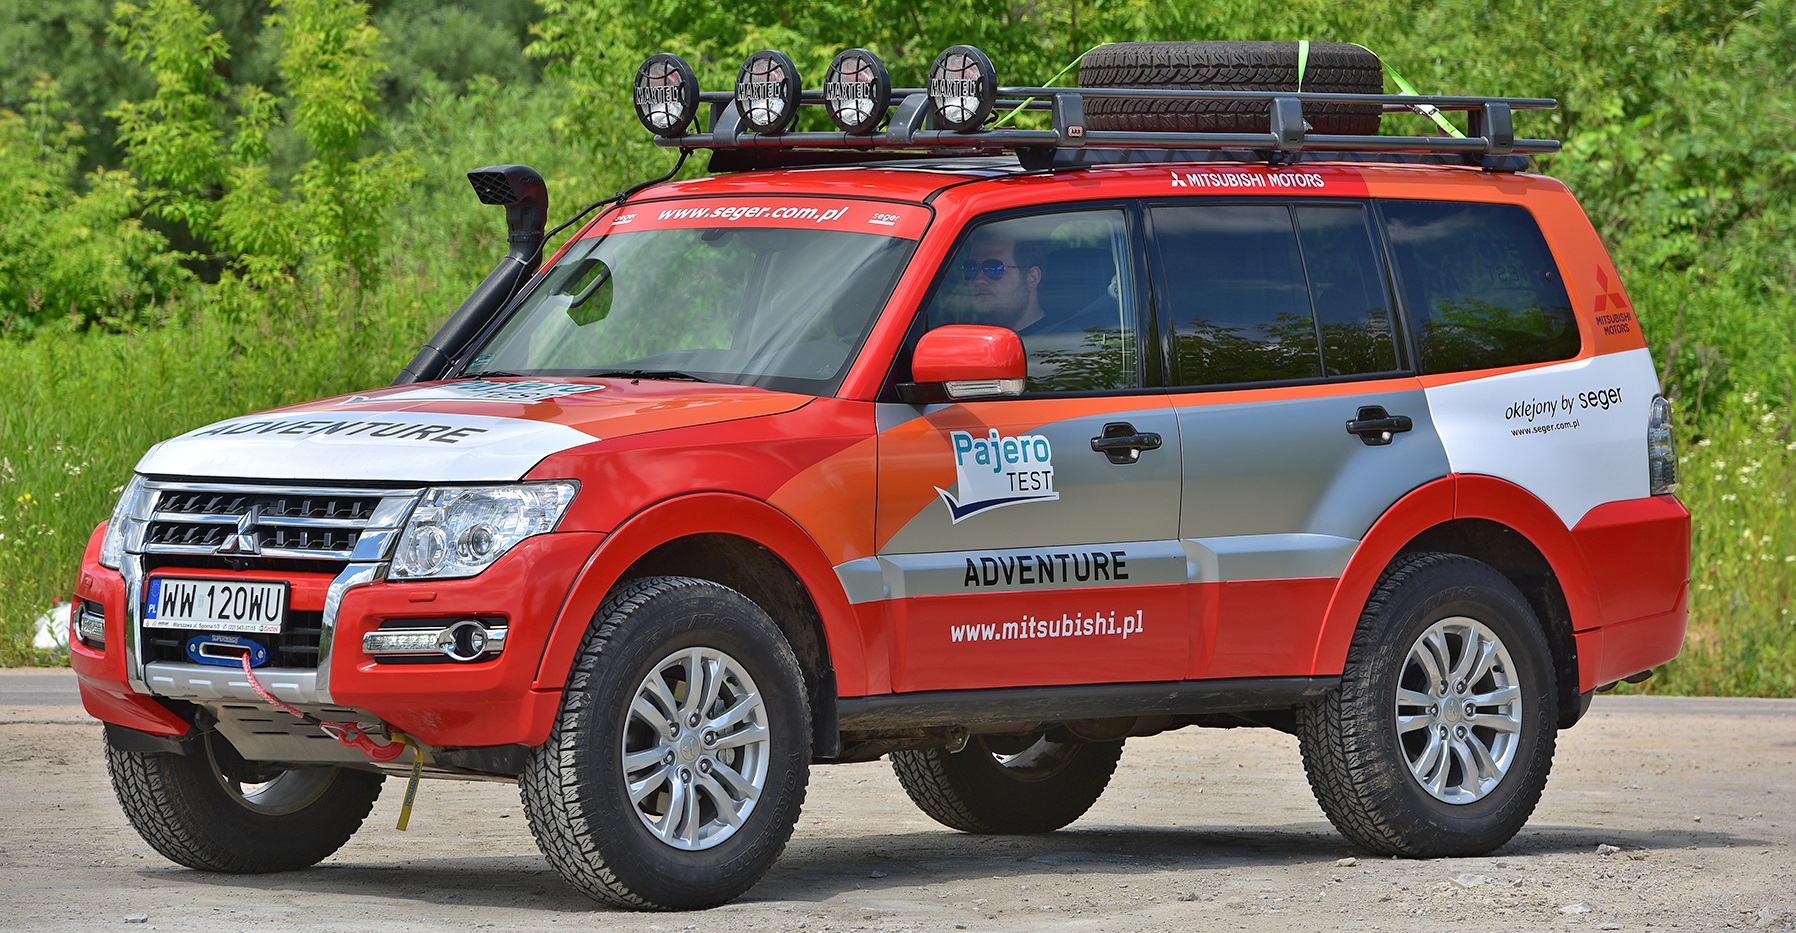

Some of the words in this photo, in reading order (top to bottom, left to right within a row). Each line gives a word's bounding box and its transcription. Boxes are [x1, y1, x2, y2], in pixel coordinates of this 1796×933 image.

[636, 85, 679, 105] MAXTEL
[737, 82, 781, 101] MAXTEL
[826, 82, 870, 100] MAXTEL
[930, 79, 976, 98] MAXTEL
[1185, 173, 1266, 187] MITSUBISHI
[1267, 173, 1325, 187] MOTORS
[656, 205, 850, 223] www.seger.com.pl
[872, 212, 900, 223] seger
[1595, 312, 1632, 326] MITSUBISHI
[1604, 323, 1630, 336] MOTORS
[1505, 399, 1557, 422] oklejony
[1561, 394, 1574, 414] by
[1578, 386, 1622, 410] seger
[193, 420, 489, 444] ADVENTURE
[1511, 419, 1580, 436] www.seger.com.pl
[953, 432, 1050, 473] Pajero
[1006, 470, 1052, 491] TEST
[964, 551, 1129, 587] ADVENTURE
[148, 604, 156, 614] PL
[162, 583, 197, 618] WW
[207, 585, 281, 622] 120WU
[950, 610, 1144, 643] www.mitsubishi.pl
